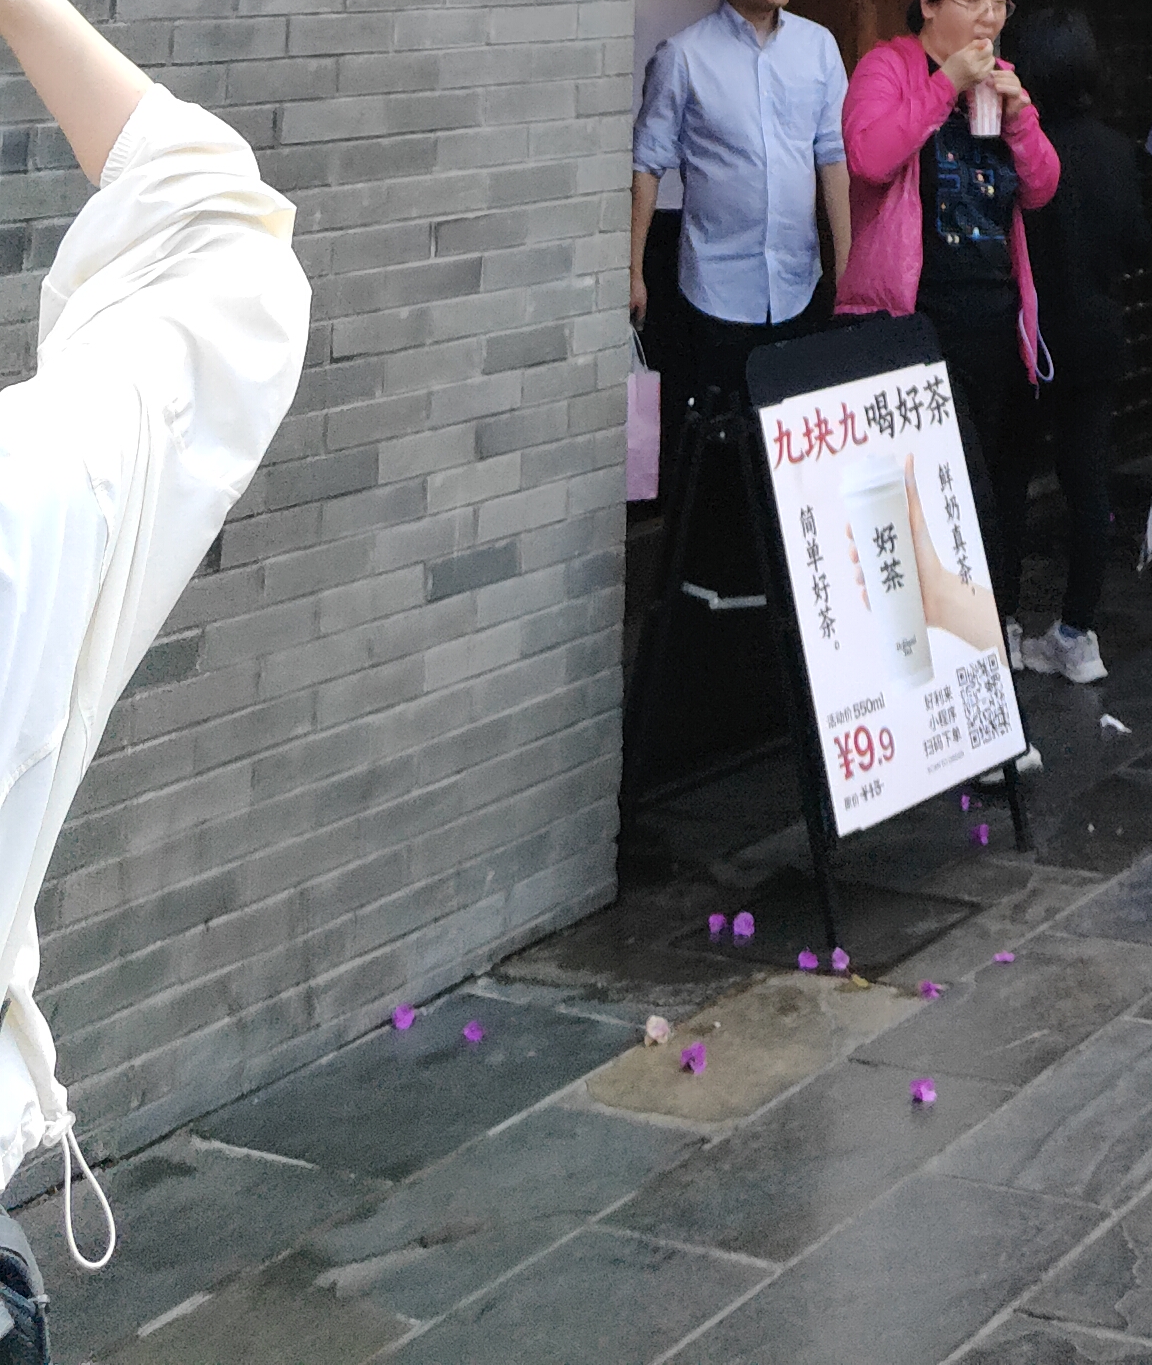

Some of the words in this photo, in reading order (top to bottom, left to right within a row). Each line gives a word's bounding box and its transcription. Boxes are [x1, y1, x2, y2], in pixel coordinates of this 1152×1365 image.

[773, 374, 952, 470] 九块九喝好茶
[872, 522, 904, 594] 好茶
[852, 691, 886, 720] 550ml
[929, 706, 957, 732] 小程序
[833, 724, 896, 781] ¥9.9
[923, 725, 962, 760] 扫码下单
